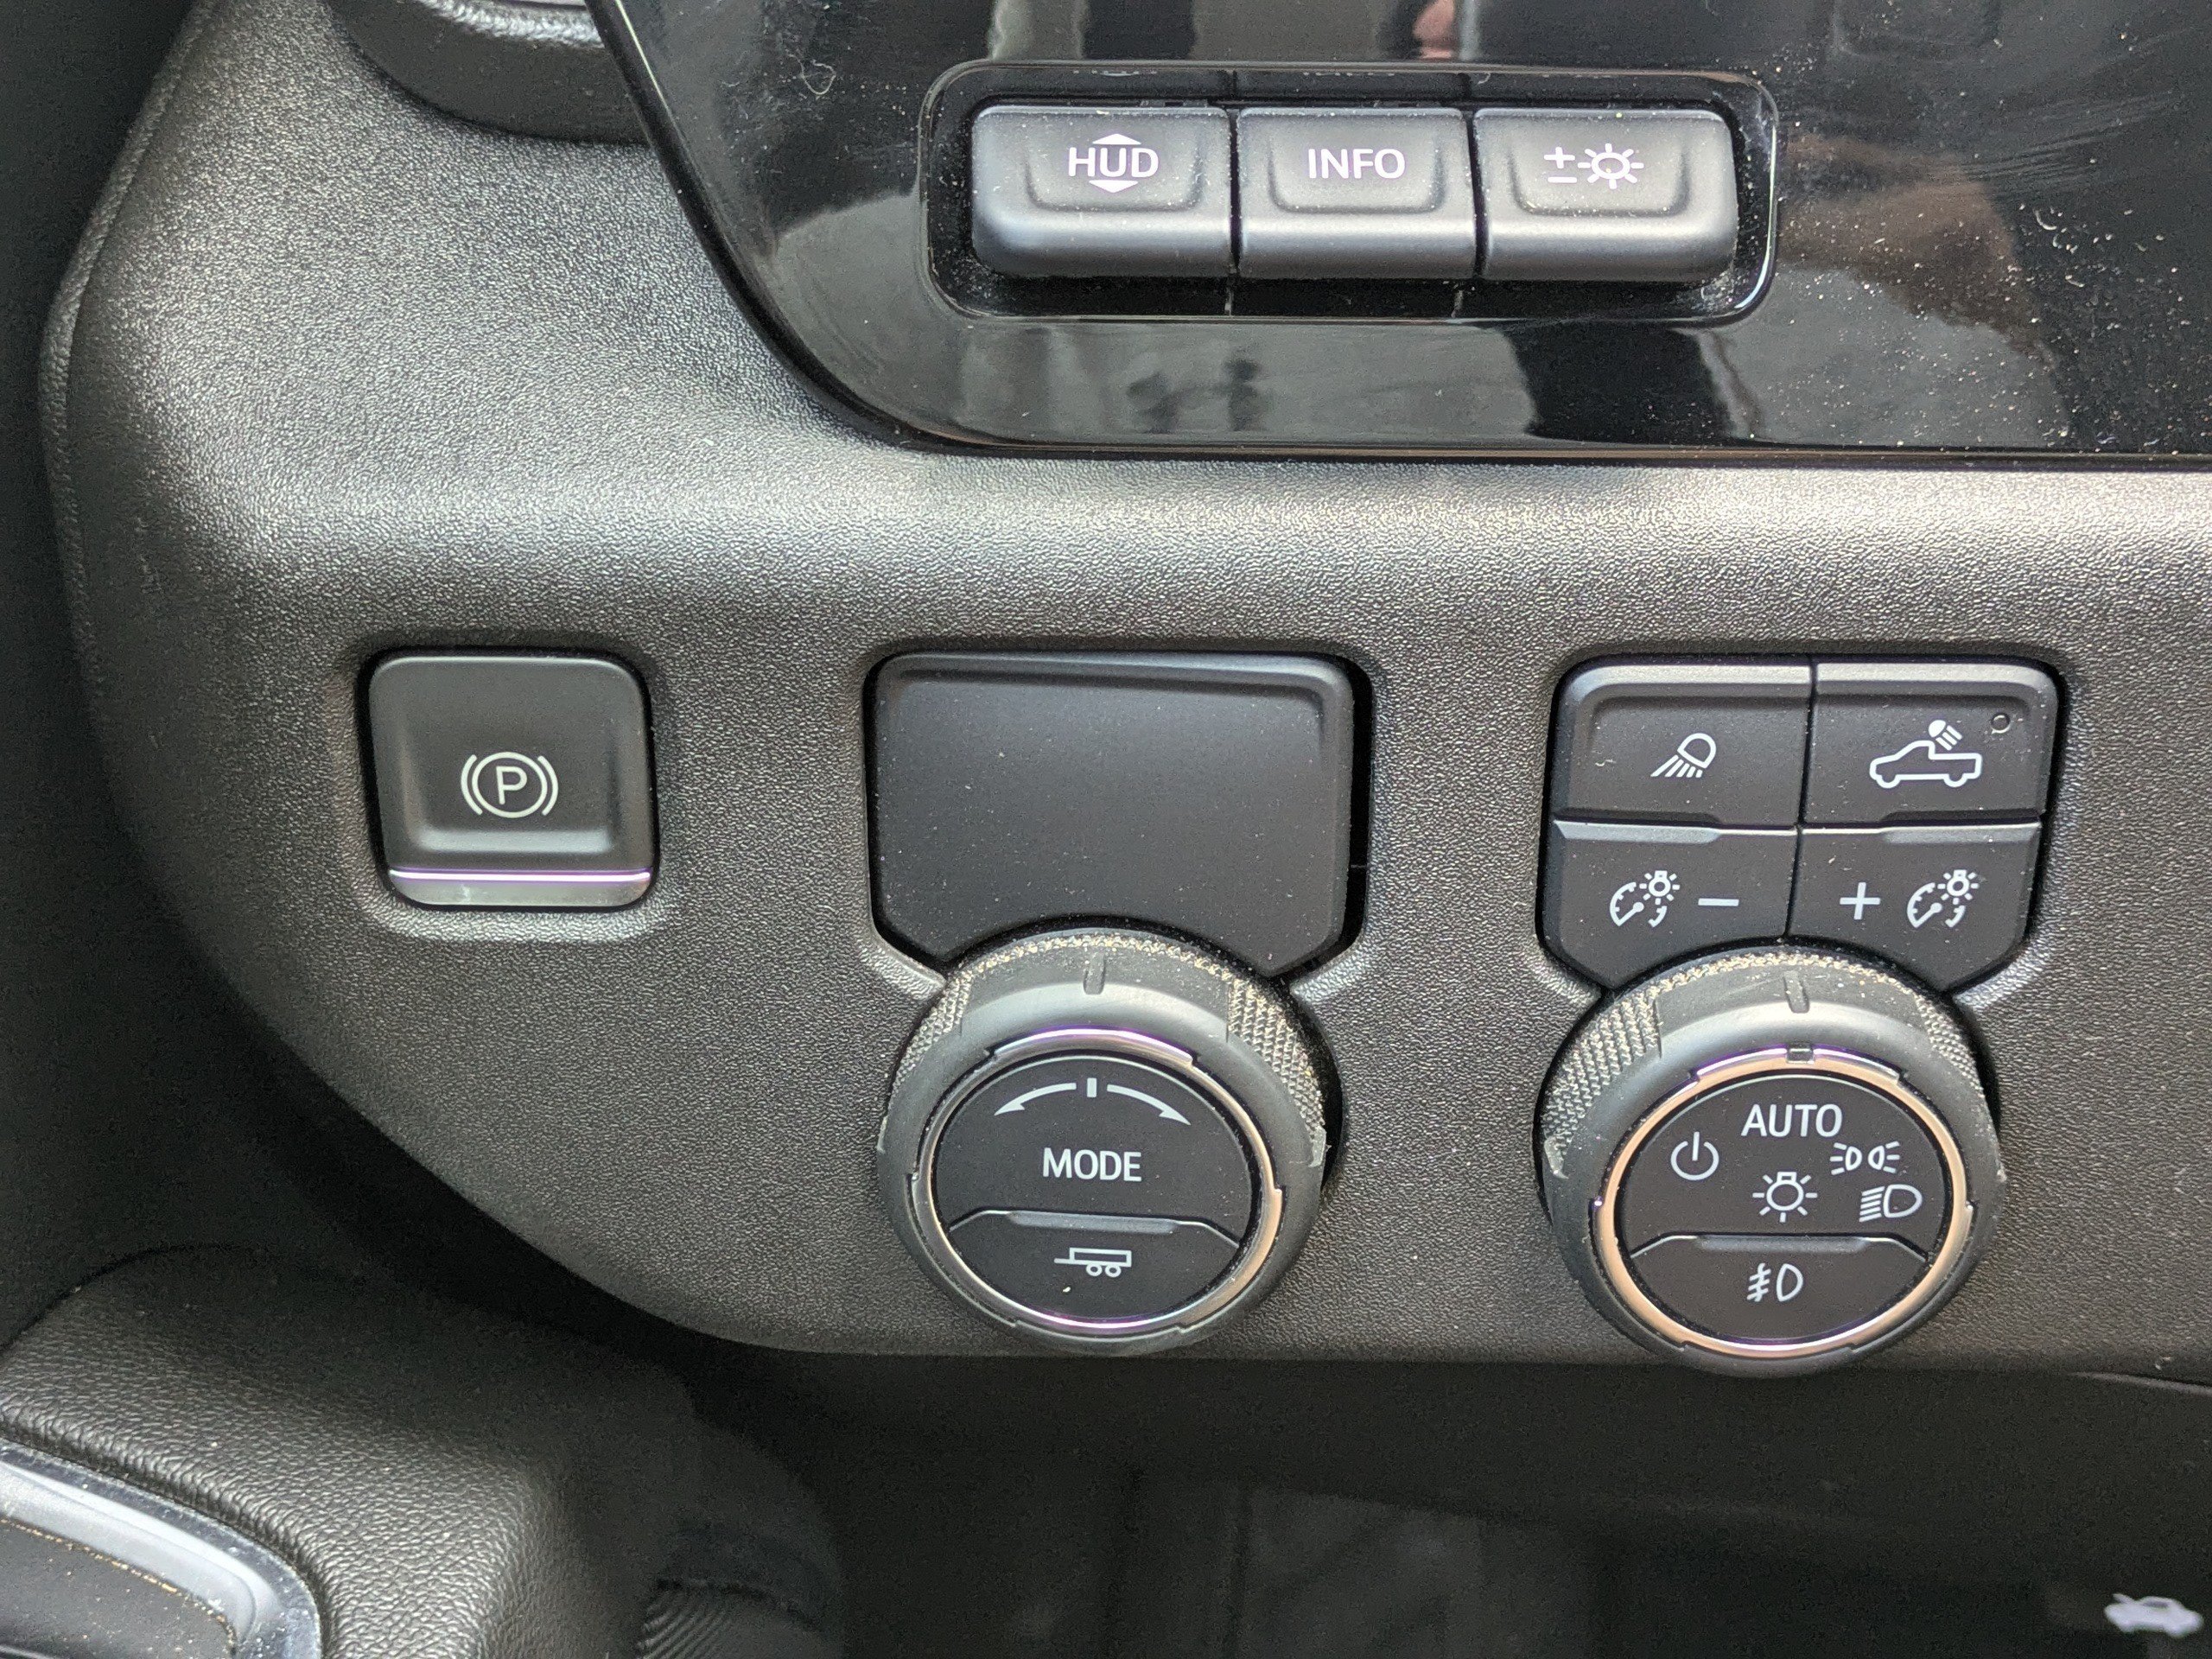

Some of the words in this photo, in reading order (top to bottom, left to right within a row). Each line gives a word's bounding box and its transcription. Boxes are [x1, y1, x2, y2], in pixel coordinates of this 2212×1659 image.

[1068, 147, 1160, 180] HUD
[1307, 147, 1406, 180] INFO
[495, 765, 528, 805] P
[1740, 1103, 1843, 1139] AUTO
[1042, 1147, 1142, 1183] MODE
